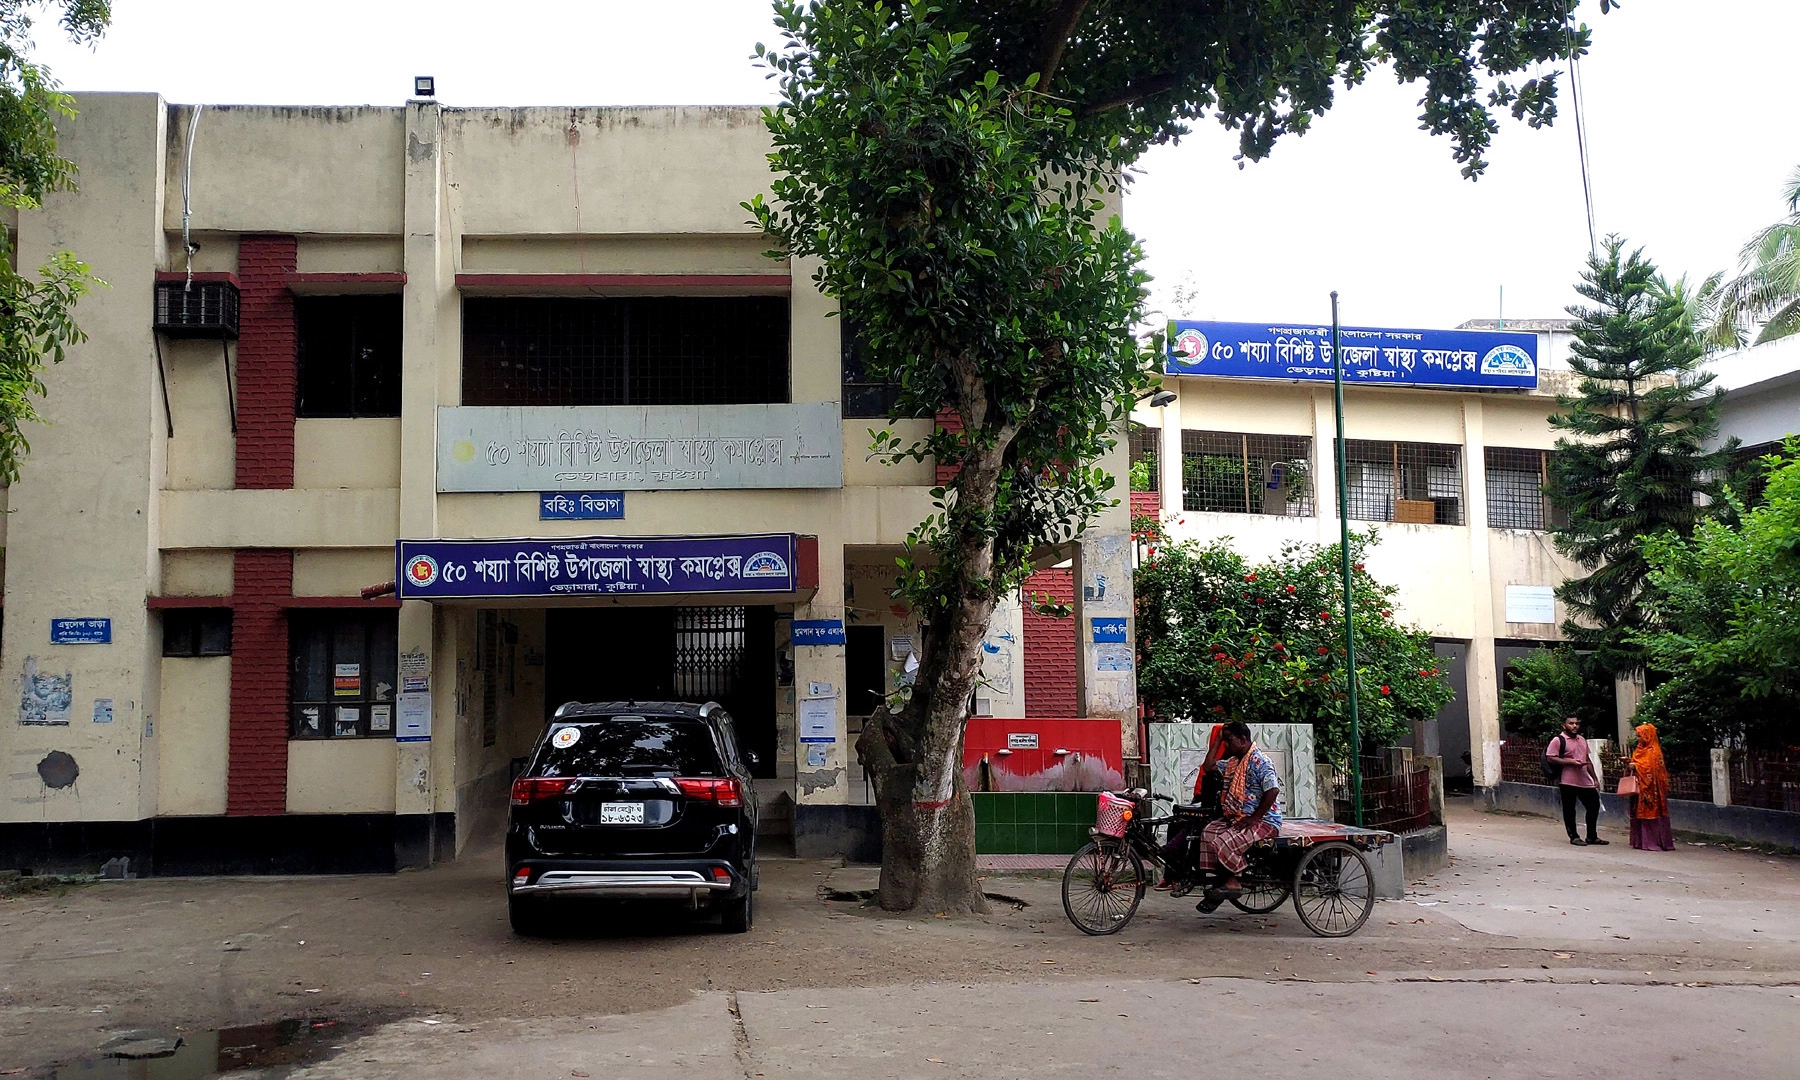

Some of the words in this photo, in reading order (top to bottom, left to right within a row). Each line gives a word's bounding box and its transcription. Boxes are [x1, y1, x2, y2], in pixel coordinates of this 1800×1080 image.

[1331, 328, 1381, 340] াংলাদেশ
[1384, 332, 1424, 341] সরকার
[1211, 341, 1234, 360] ৫০
[1237, 339, 1272, 363] শয্যা
[1274, 336, 1316, 364] বিশিষ্ট
[1319, 338, 1380, 367] উজেলা
[1382, 345, 1418, 373] স্বাস্থ্য
[1420, 348, 1478, 373] কমপ্লেক্স
[485, 439, 511, 467] ৫০
[556, 429, 603, 467] বিশিষ্ট
[605, 429, 675, 467] উপজেলা
[719, 434, 785, 467] কমপ্লেক্স
[542, 494, 575, 515] বহিঃ
[578, 494, 621, 513] বিভাগ
[442, 561, 467, 583] ৫০
[472, 557, 511, 583] শয্যা
[513, 551, 561, 582] বিশিষ্ট
[564, 550, 633, 581] উপজেলা
[635, 554, 676, 585] স্বাস্থ্য
[679, 553, 742, 581] কমপ্লেক্স
